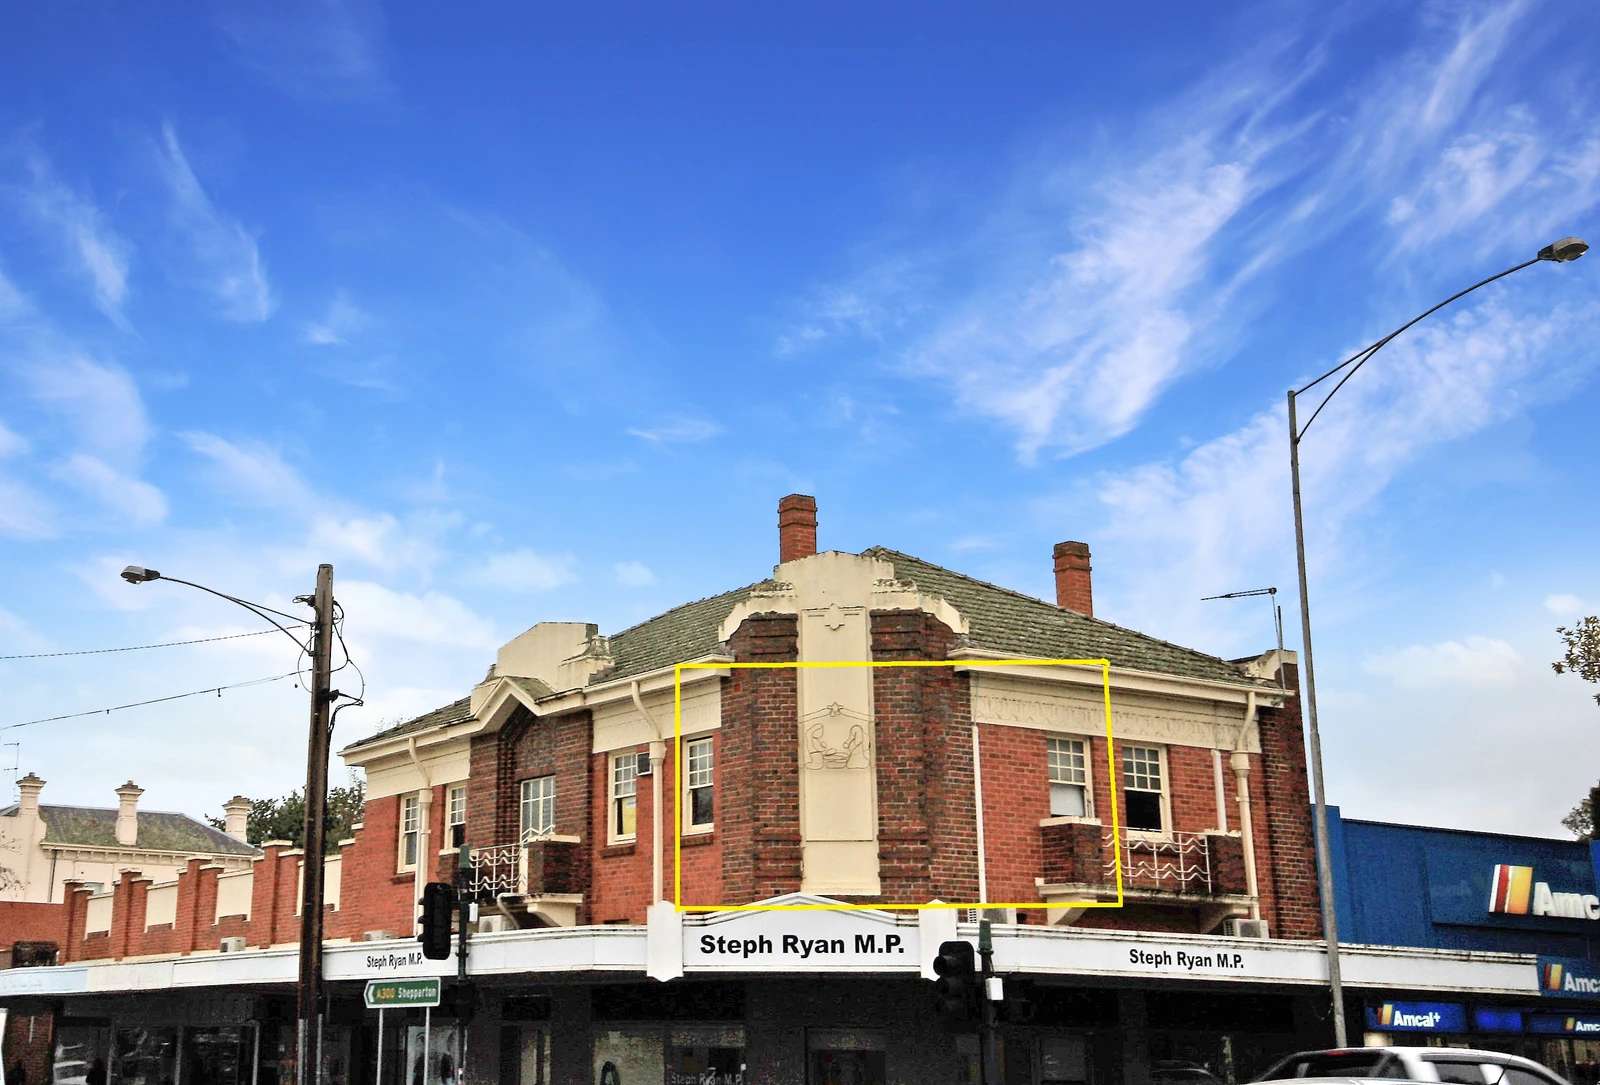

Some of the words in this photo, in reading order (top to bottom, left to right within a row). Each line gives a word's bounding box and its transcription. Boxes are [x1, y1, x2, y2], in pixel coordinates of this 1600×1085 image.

[700, 935, 773, 958] Steph
[782, 935, 845, 958] Ryan
[854, 935, 905, 954] M.P.
[367, 955, 387, 970] Steph
[389, 954, 407, 969] Ryan
[409, 952, 423, 965] M.P.
[1129, 949, 1172, 968] Steph
[1177, 951, 1212, 970] Ryan
[1217, 953, 1245, 968] M.P.
[398, 986, 437, 1000] Shepparton
